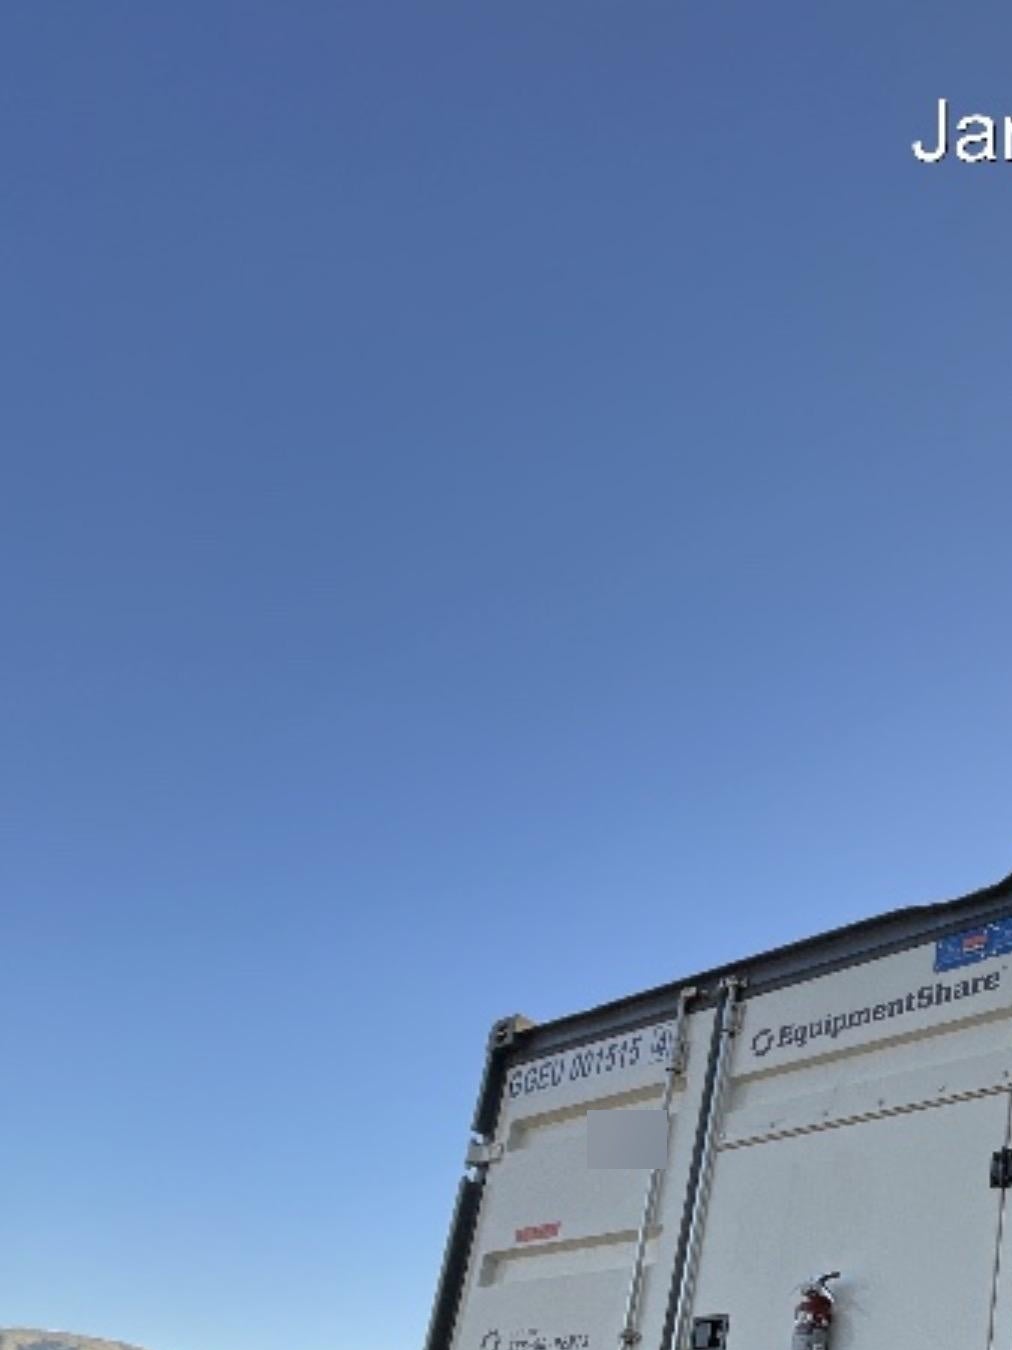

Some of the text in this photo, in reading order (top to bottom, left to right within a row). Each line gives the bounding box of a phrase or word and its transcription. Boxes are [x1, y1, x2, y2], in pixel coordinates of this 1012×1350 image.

[776, 970, 1001, 1048] EquipmentShare
[509, 1058, 565, 1098] GGEU
[569, 1036, 643, 1082] 001515
